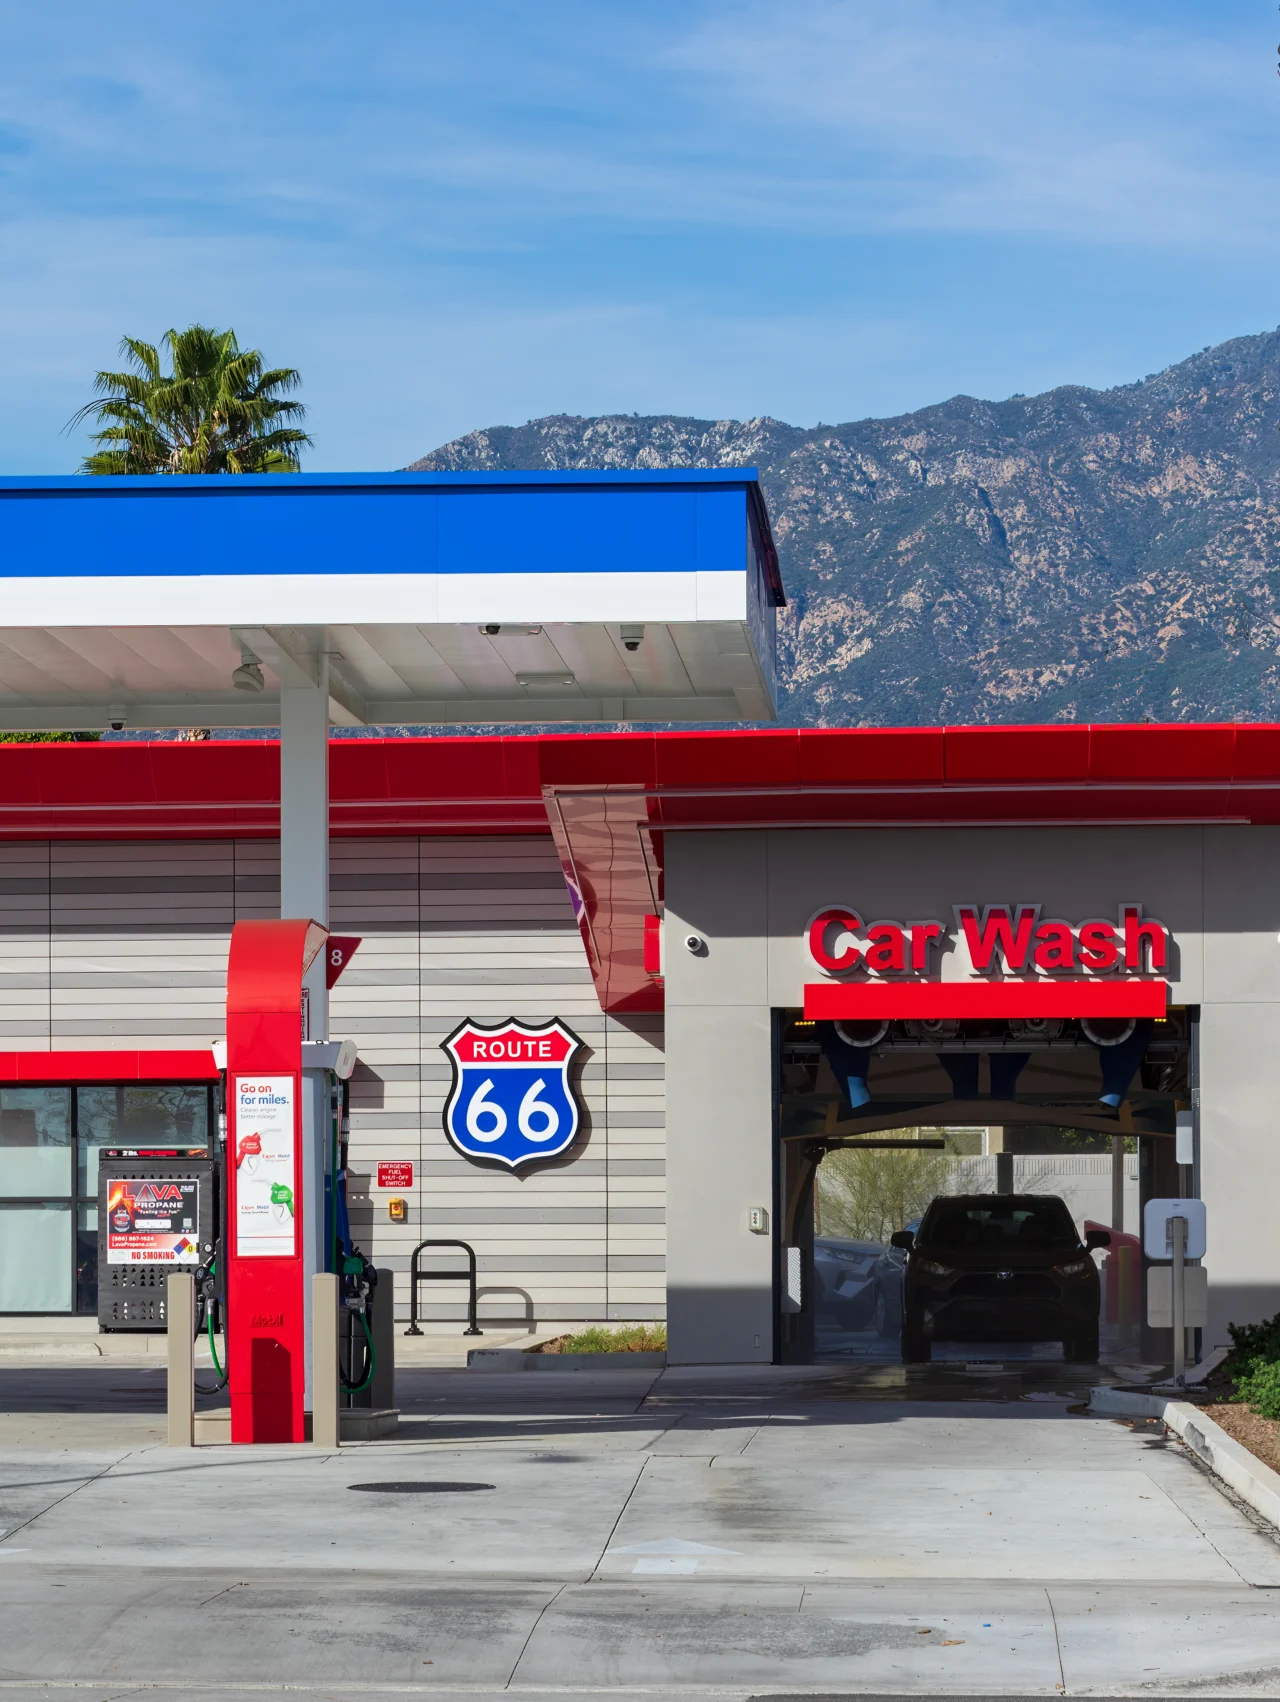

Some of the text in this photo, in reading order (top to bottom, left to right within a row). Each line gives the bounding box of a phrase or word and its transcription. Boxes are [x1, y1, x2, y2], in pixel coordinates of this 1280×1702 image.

[809, 907, 1167, 970] Car Wash
[330, 950, 342, 966] 8
[473, 1040, 552, 1058] ROUTE
[240, 1084, 256, 1093] Go
[241, 1094, 289, 1104] for miles.
[466, 1078, 560, 1142] 66
[122, 1184, 182, 1201] LAVA
[251, 1313, 284, 1328] Mobil
